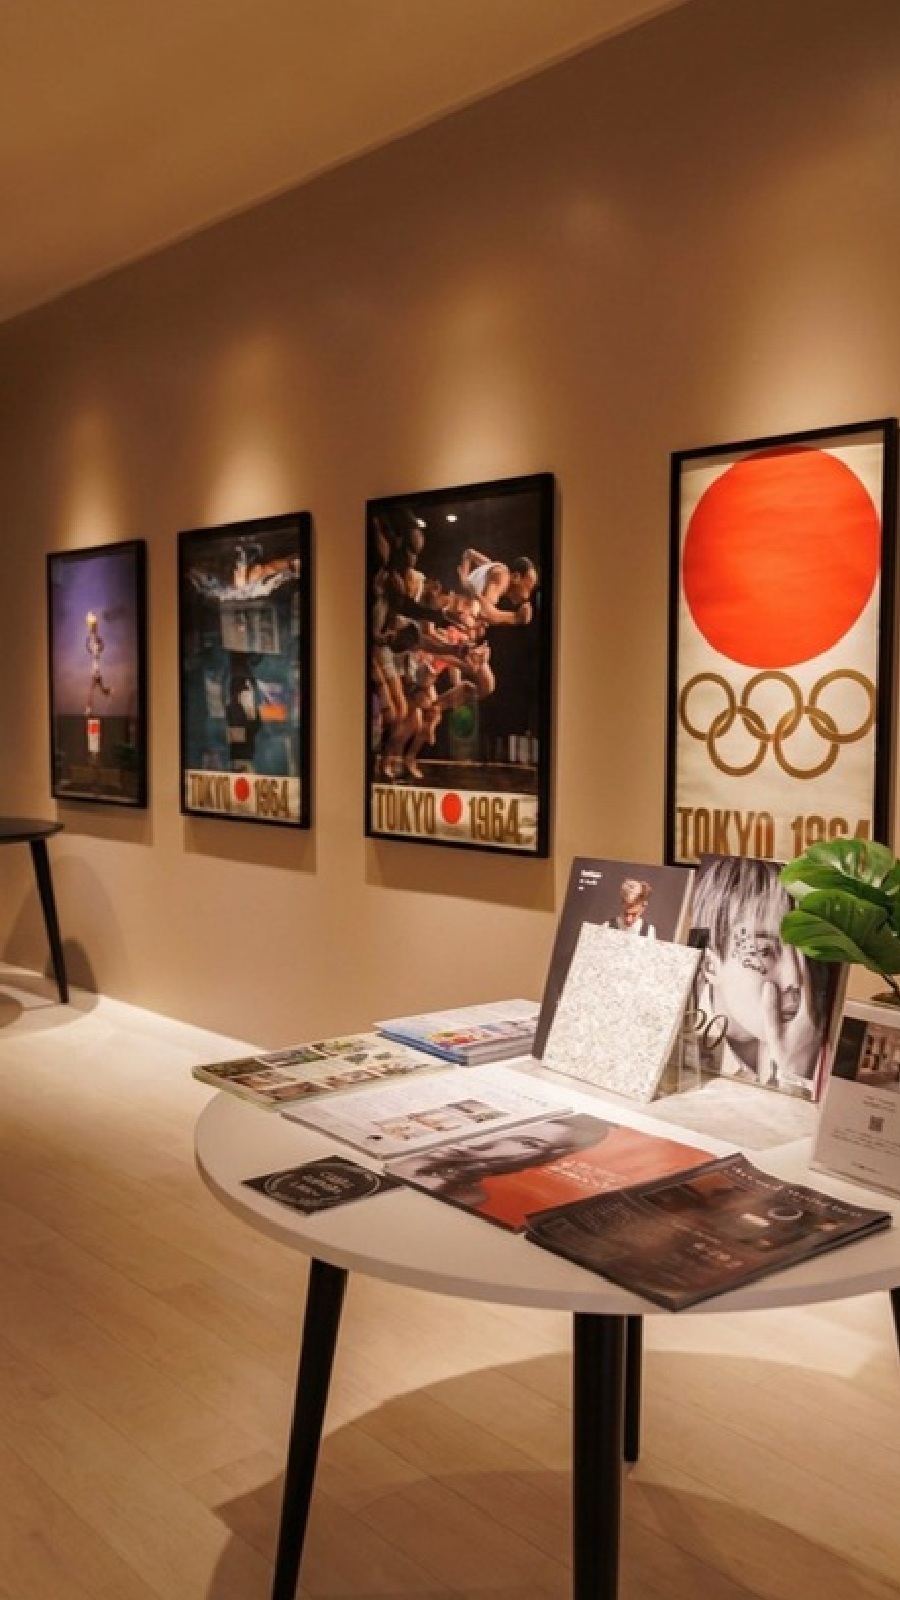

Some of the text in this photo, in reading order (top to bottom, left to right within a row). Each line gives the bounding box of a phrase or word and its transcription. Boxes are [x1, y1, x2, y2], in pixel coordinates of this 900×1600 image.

[189, 774, 290, 818] TOKYO 1964
[374, 788, 522, 844] TOKYO 1964
[677, 806, 775, 858] TOKYO
